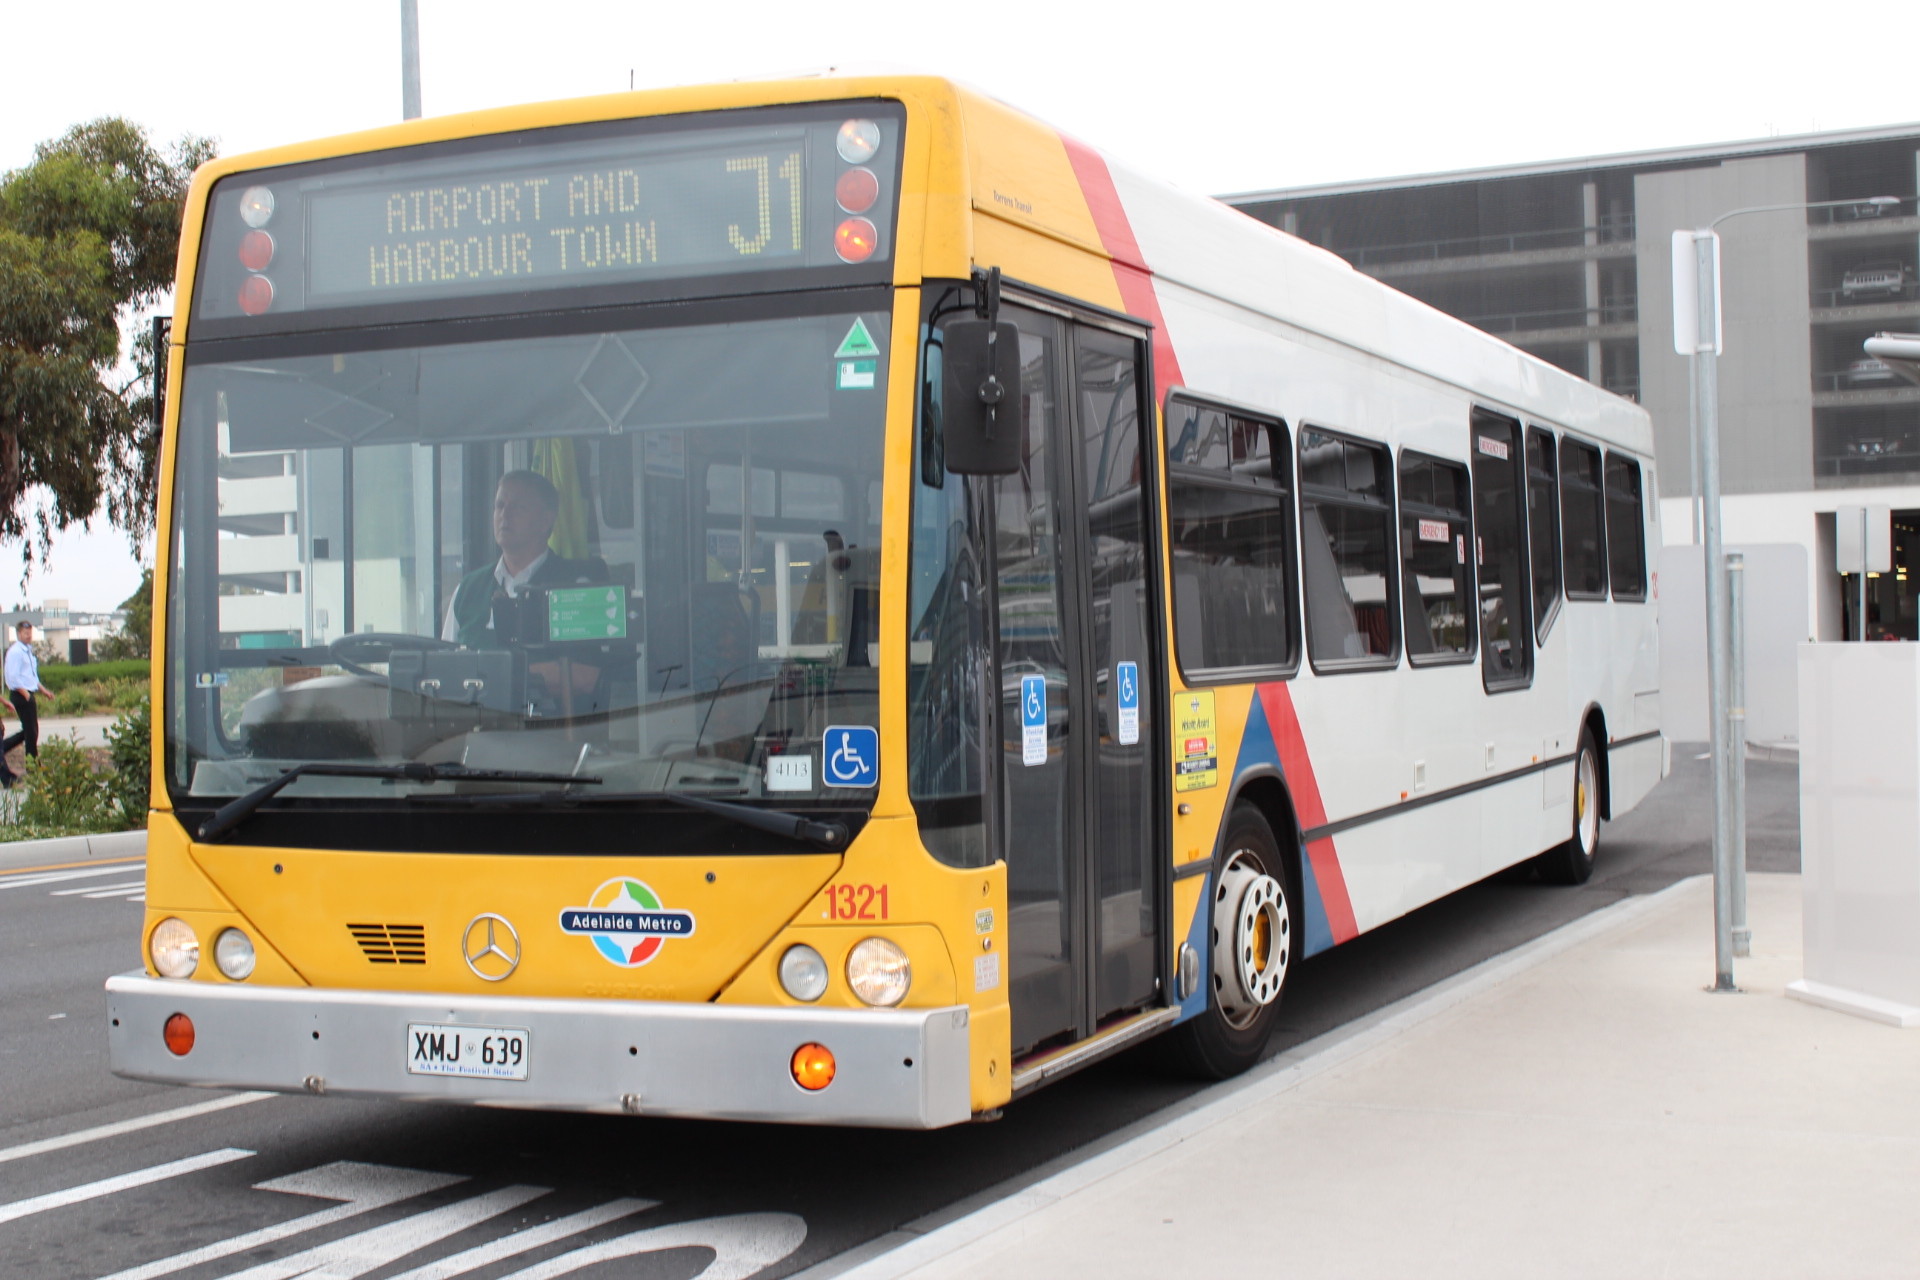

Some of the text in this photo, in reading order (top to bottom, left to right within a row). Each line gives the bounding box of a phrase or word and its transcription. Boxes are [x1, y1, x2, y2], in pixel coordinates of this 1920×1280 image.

[387, 170, 640, 234] AIRPORT AND
[726, 153, 801, 255] J1
[993, 189, 1013, 208] Torrens
[370, 219, 658, 286] HARBOUR TOWN
[775, 762, 807, 777] 4113
[824, 884, 888, 920] 1321
[572, 914, 682, 931] Adelaide Metro
[414, 1032, 522, 1067] XMJ 639
[441, 1064, 456, 1072] The
[459, 1065, 490, 1075] Festival
[493, 1068, 515, 1077] State
